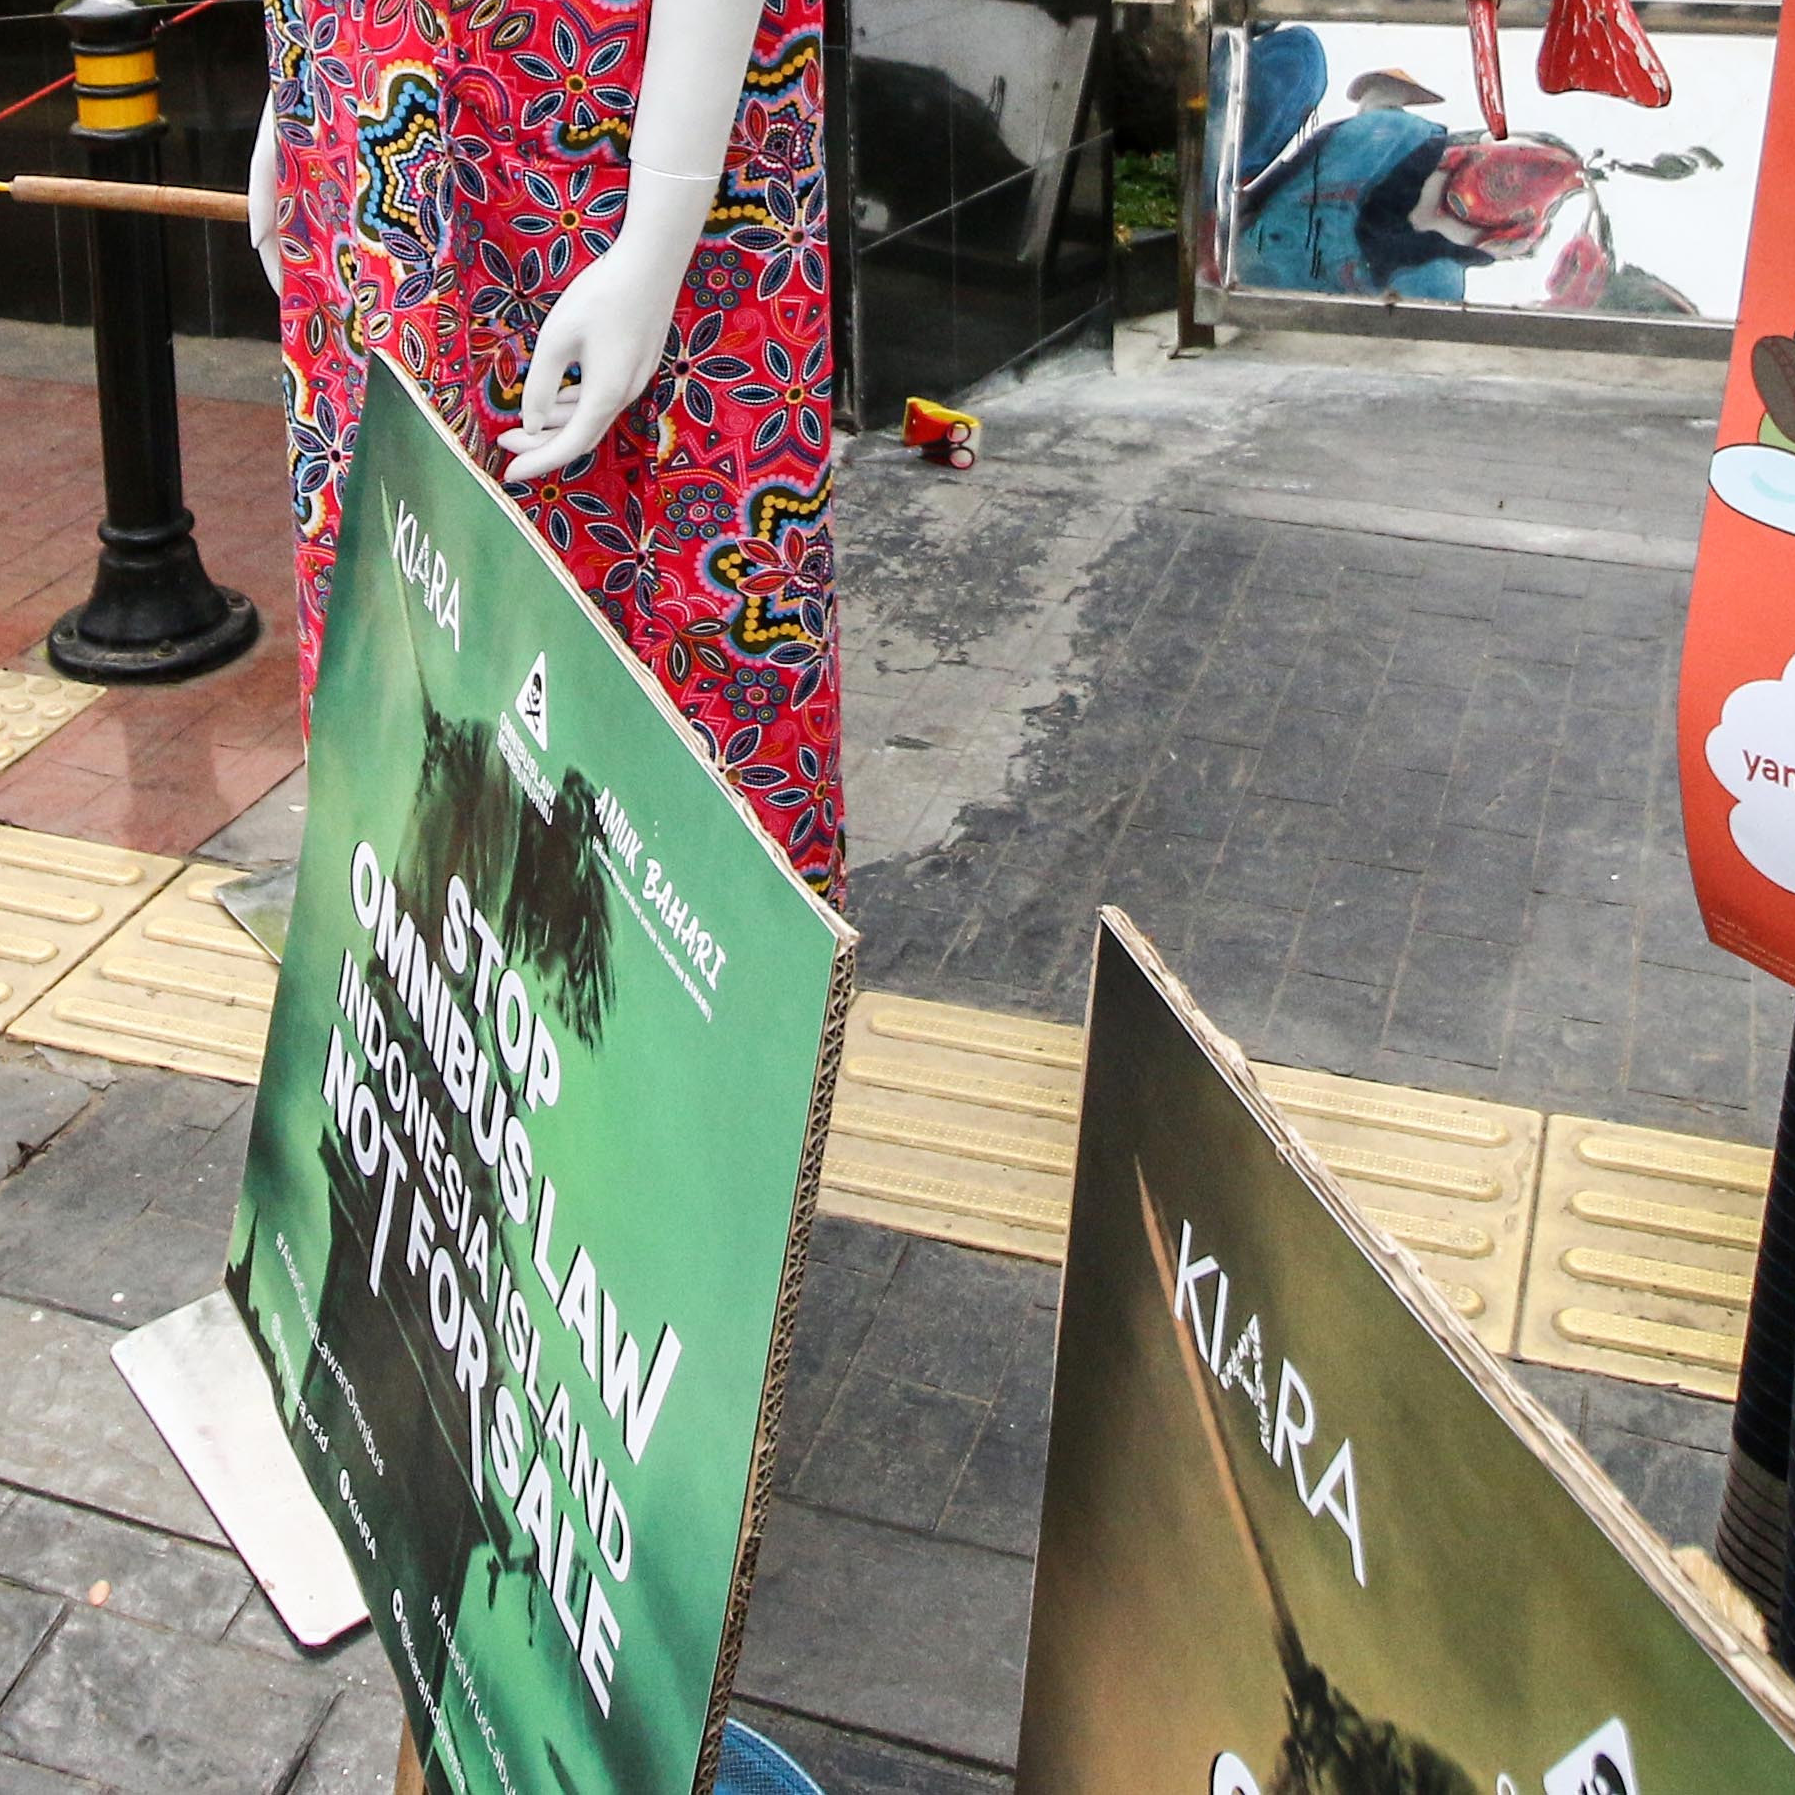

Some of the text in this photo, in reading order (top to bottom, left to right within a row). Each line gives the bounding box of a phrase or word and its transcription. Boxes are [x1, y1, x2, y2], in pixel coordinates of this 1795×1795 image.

[392, 500, 461, 651] KIARA
[442, 874, 560, 1118] STOP
[594, 786, 727, 990] AMUK BAHARI
[337, 949, 634, 1585] INDONESIA ISLAND
[350, 841, 681, 1465] OMNIBUS LAW
[323, 1024, 623, 1720] NOT FOR SALE
[347, 1491, 377, 1561] KIARA
[1174, 1217, 1367, 1589] KIARA
